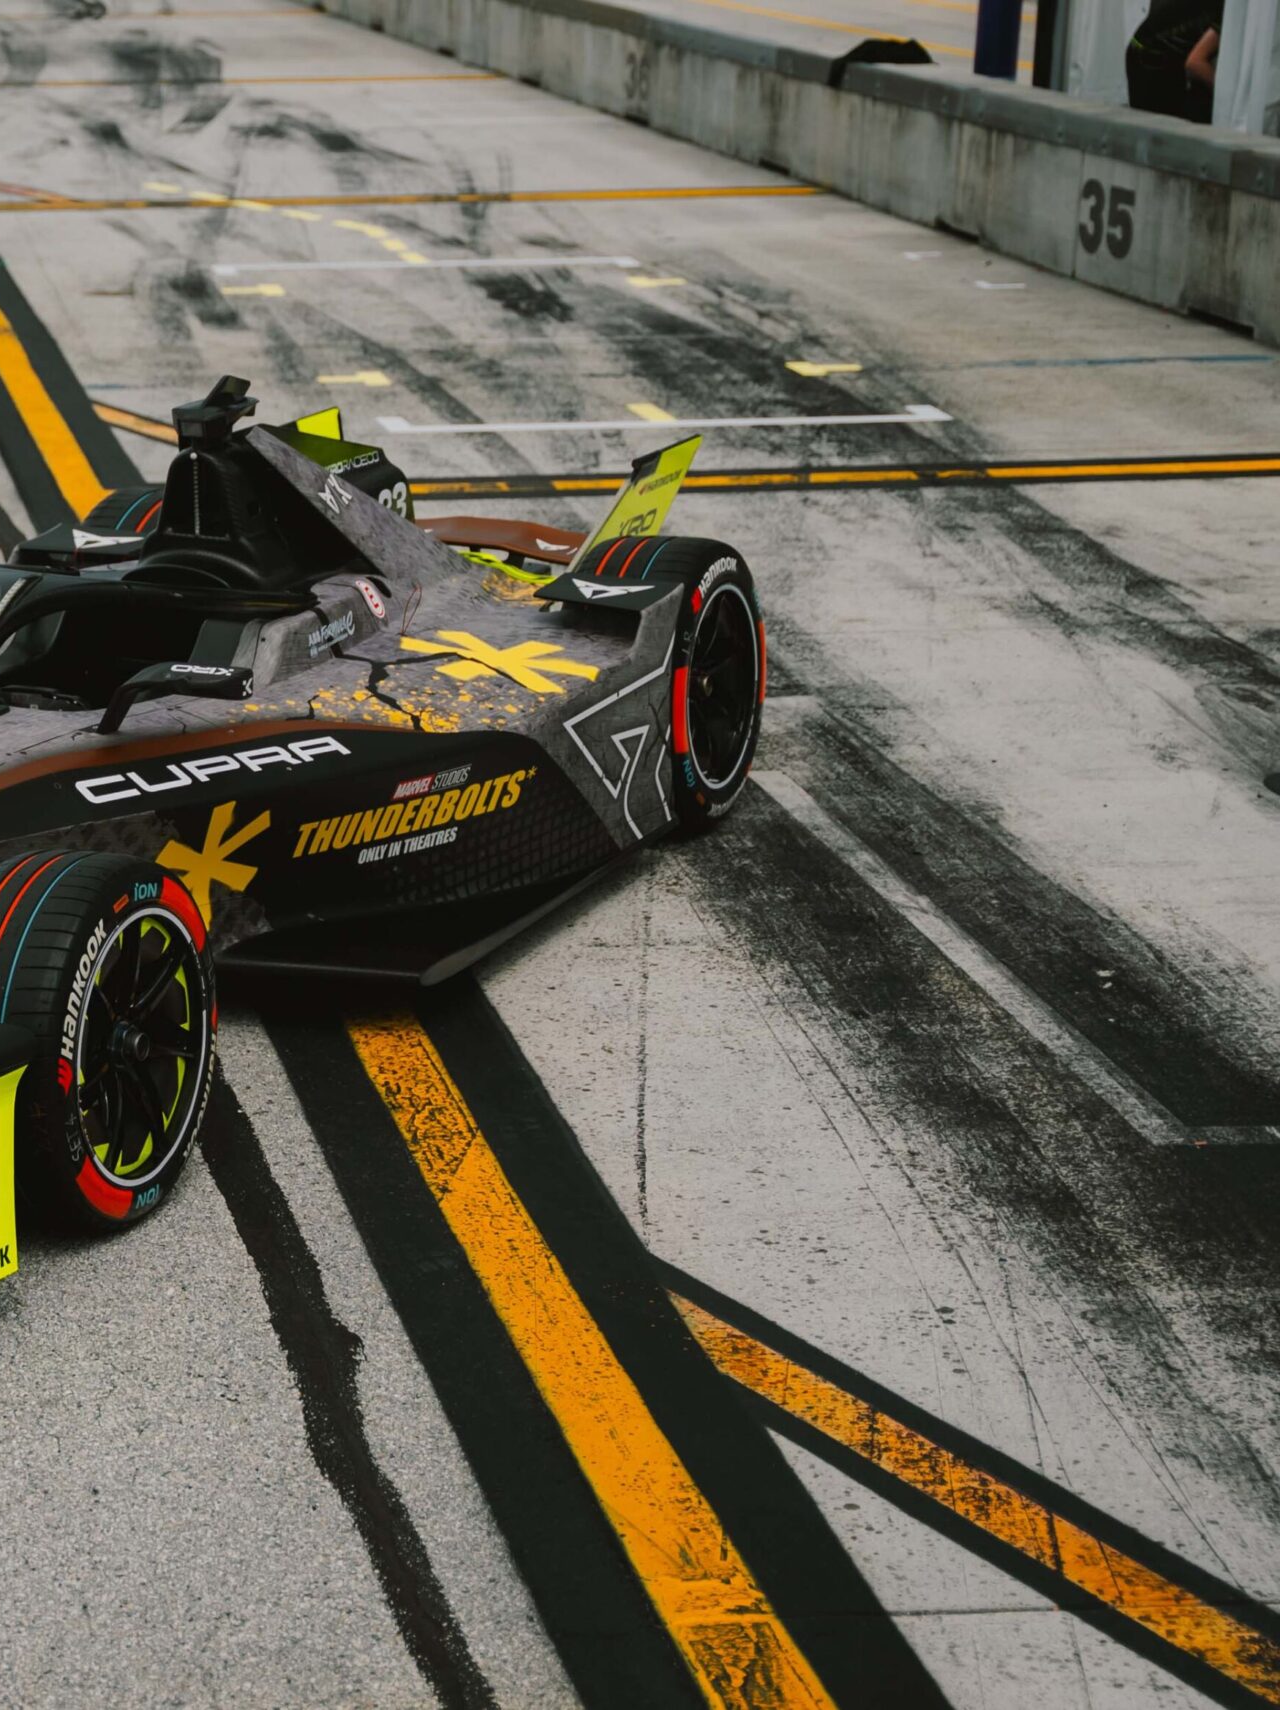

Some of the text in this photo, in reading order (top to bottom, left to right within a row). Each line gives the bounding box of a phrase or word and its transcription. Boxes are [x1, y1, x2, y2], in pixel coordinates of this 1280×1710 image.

[1079, 178, 1136, 260] 35
[75, 736, 352, 804] CUPRA
[393, 764, 472, 799] MARVEL STUDIOS
[358, 827, 458, 864] ONLY IN THEATRES
